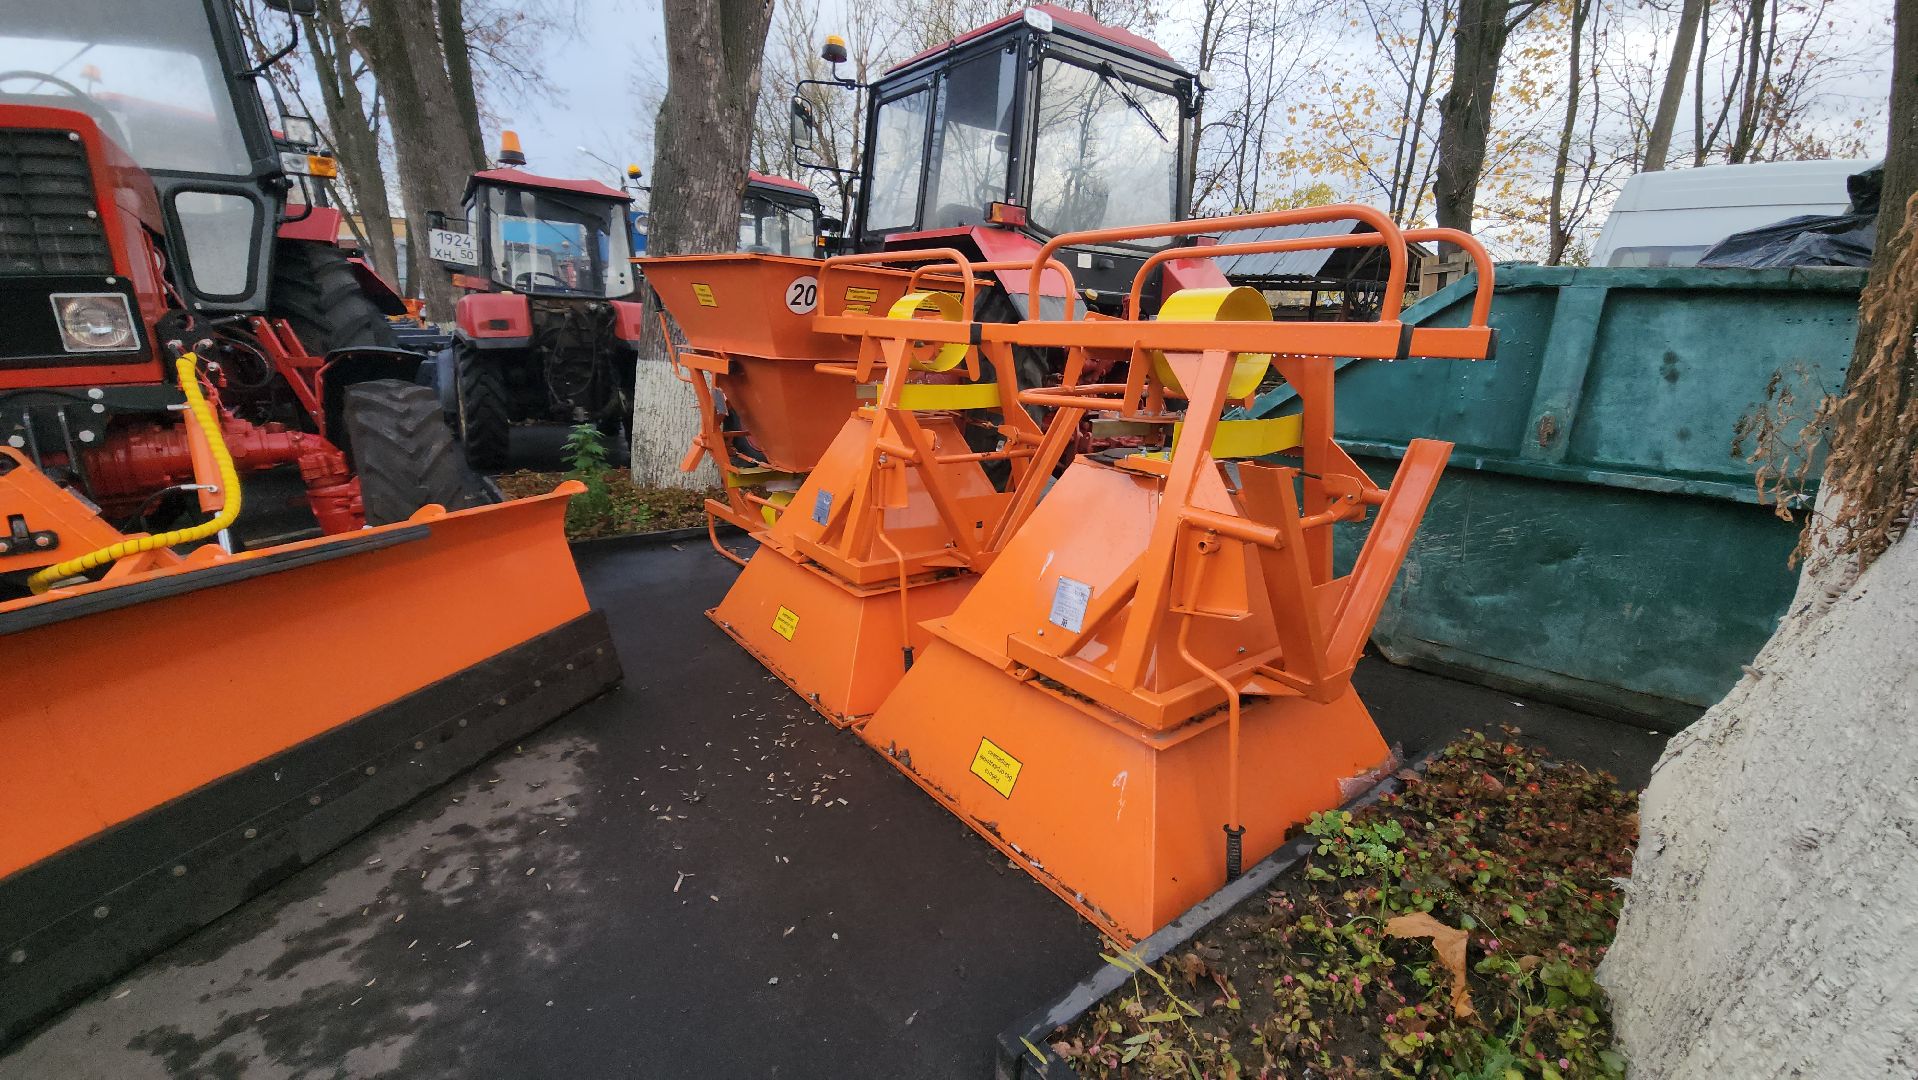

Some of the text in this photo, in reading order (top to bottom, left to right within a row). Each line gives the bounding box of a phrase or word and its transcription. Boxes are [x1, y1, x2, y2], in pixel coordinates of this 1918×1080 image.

[437, 232, 471, 248] 1924
[460, 250, 474, 260] 50
[790, 283, 817, 306] 20
